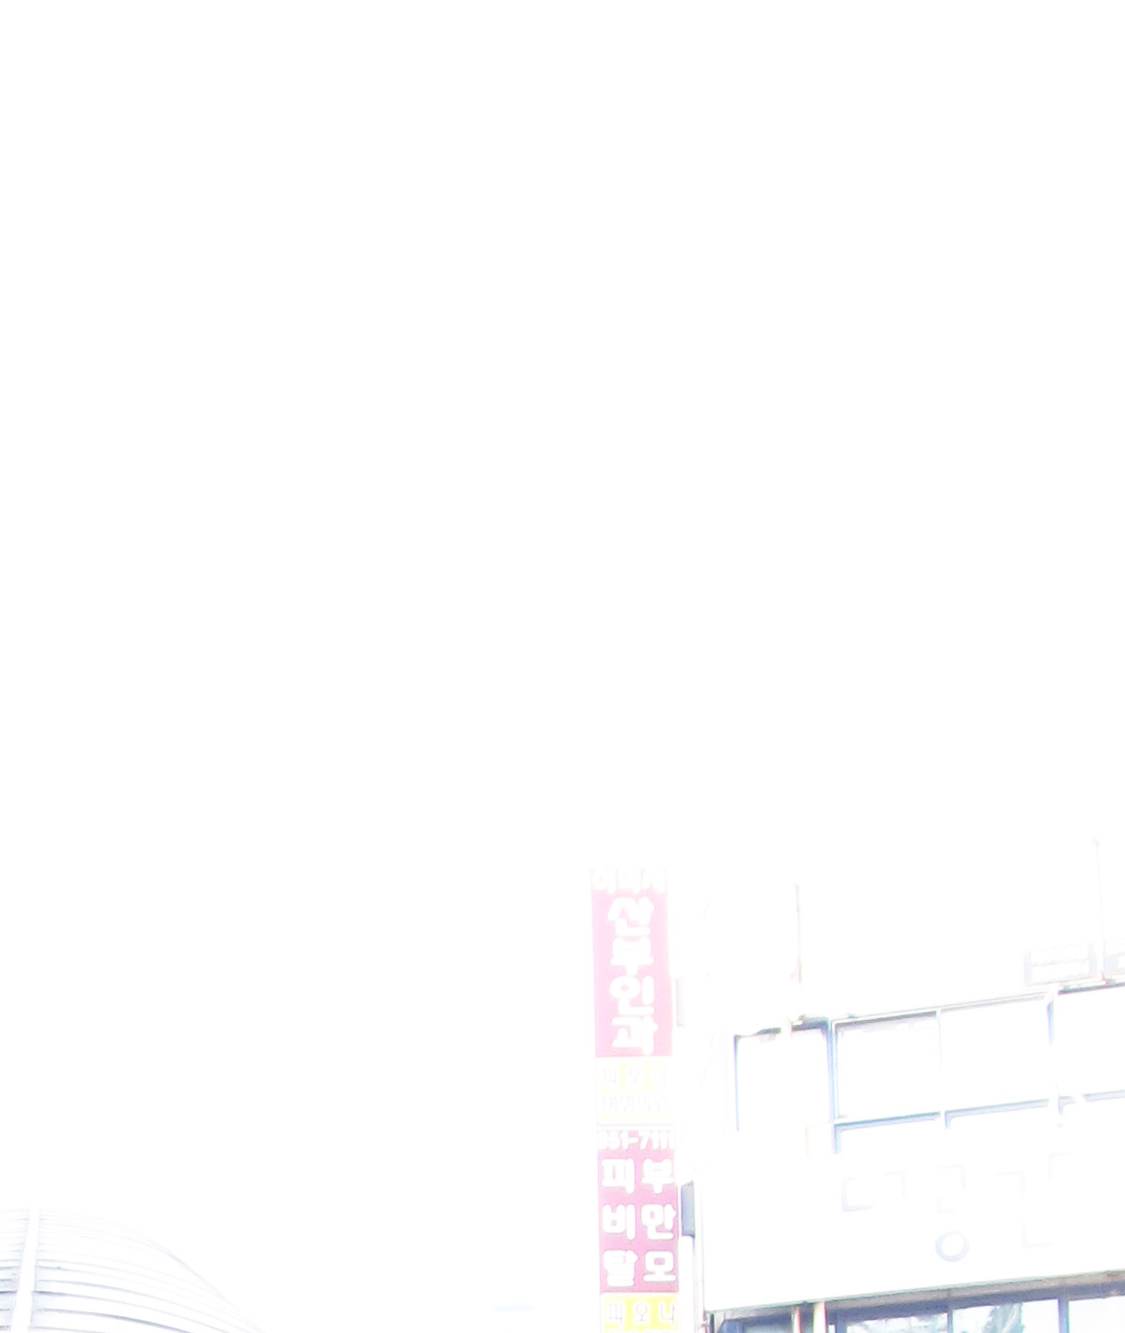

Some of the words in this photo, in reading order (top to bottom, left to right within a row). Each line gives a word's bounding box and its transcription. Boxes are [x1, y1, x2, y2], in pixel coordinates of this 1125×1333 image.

[608, 897, 658, 1056] 산부인과
[601, 1158, 675, 1195] 피부
[602, 1204, 677, 1240] 비만
[602, 1250, 676, 1287] 탈모
[608, 1302, 676, 1324] 피오나
